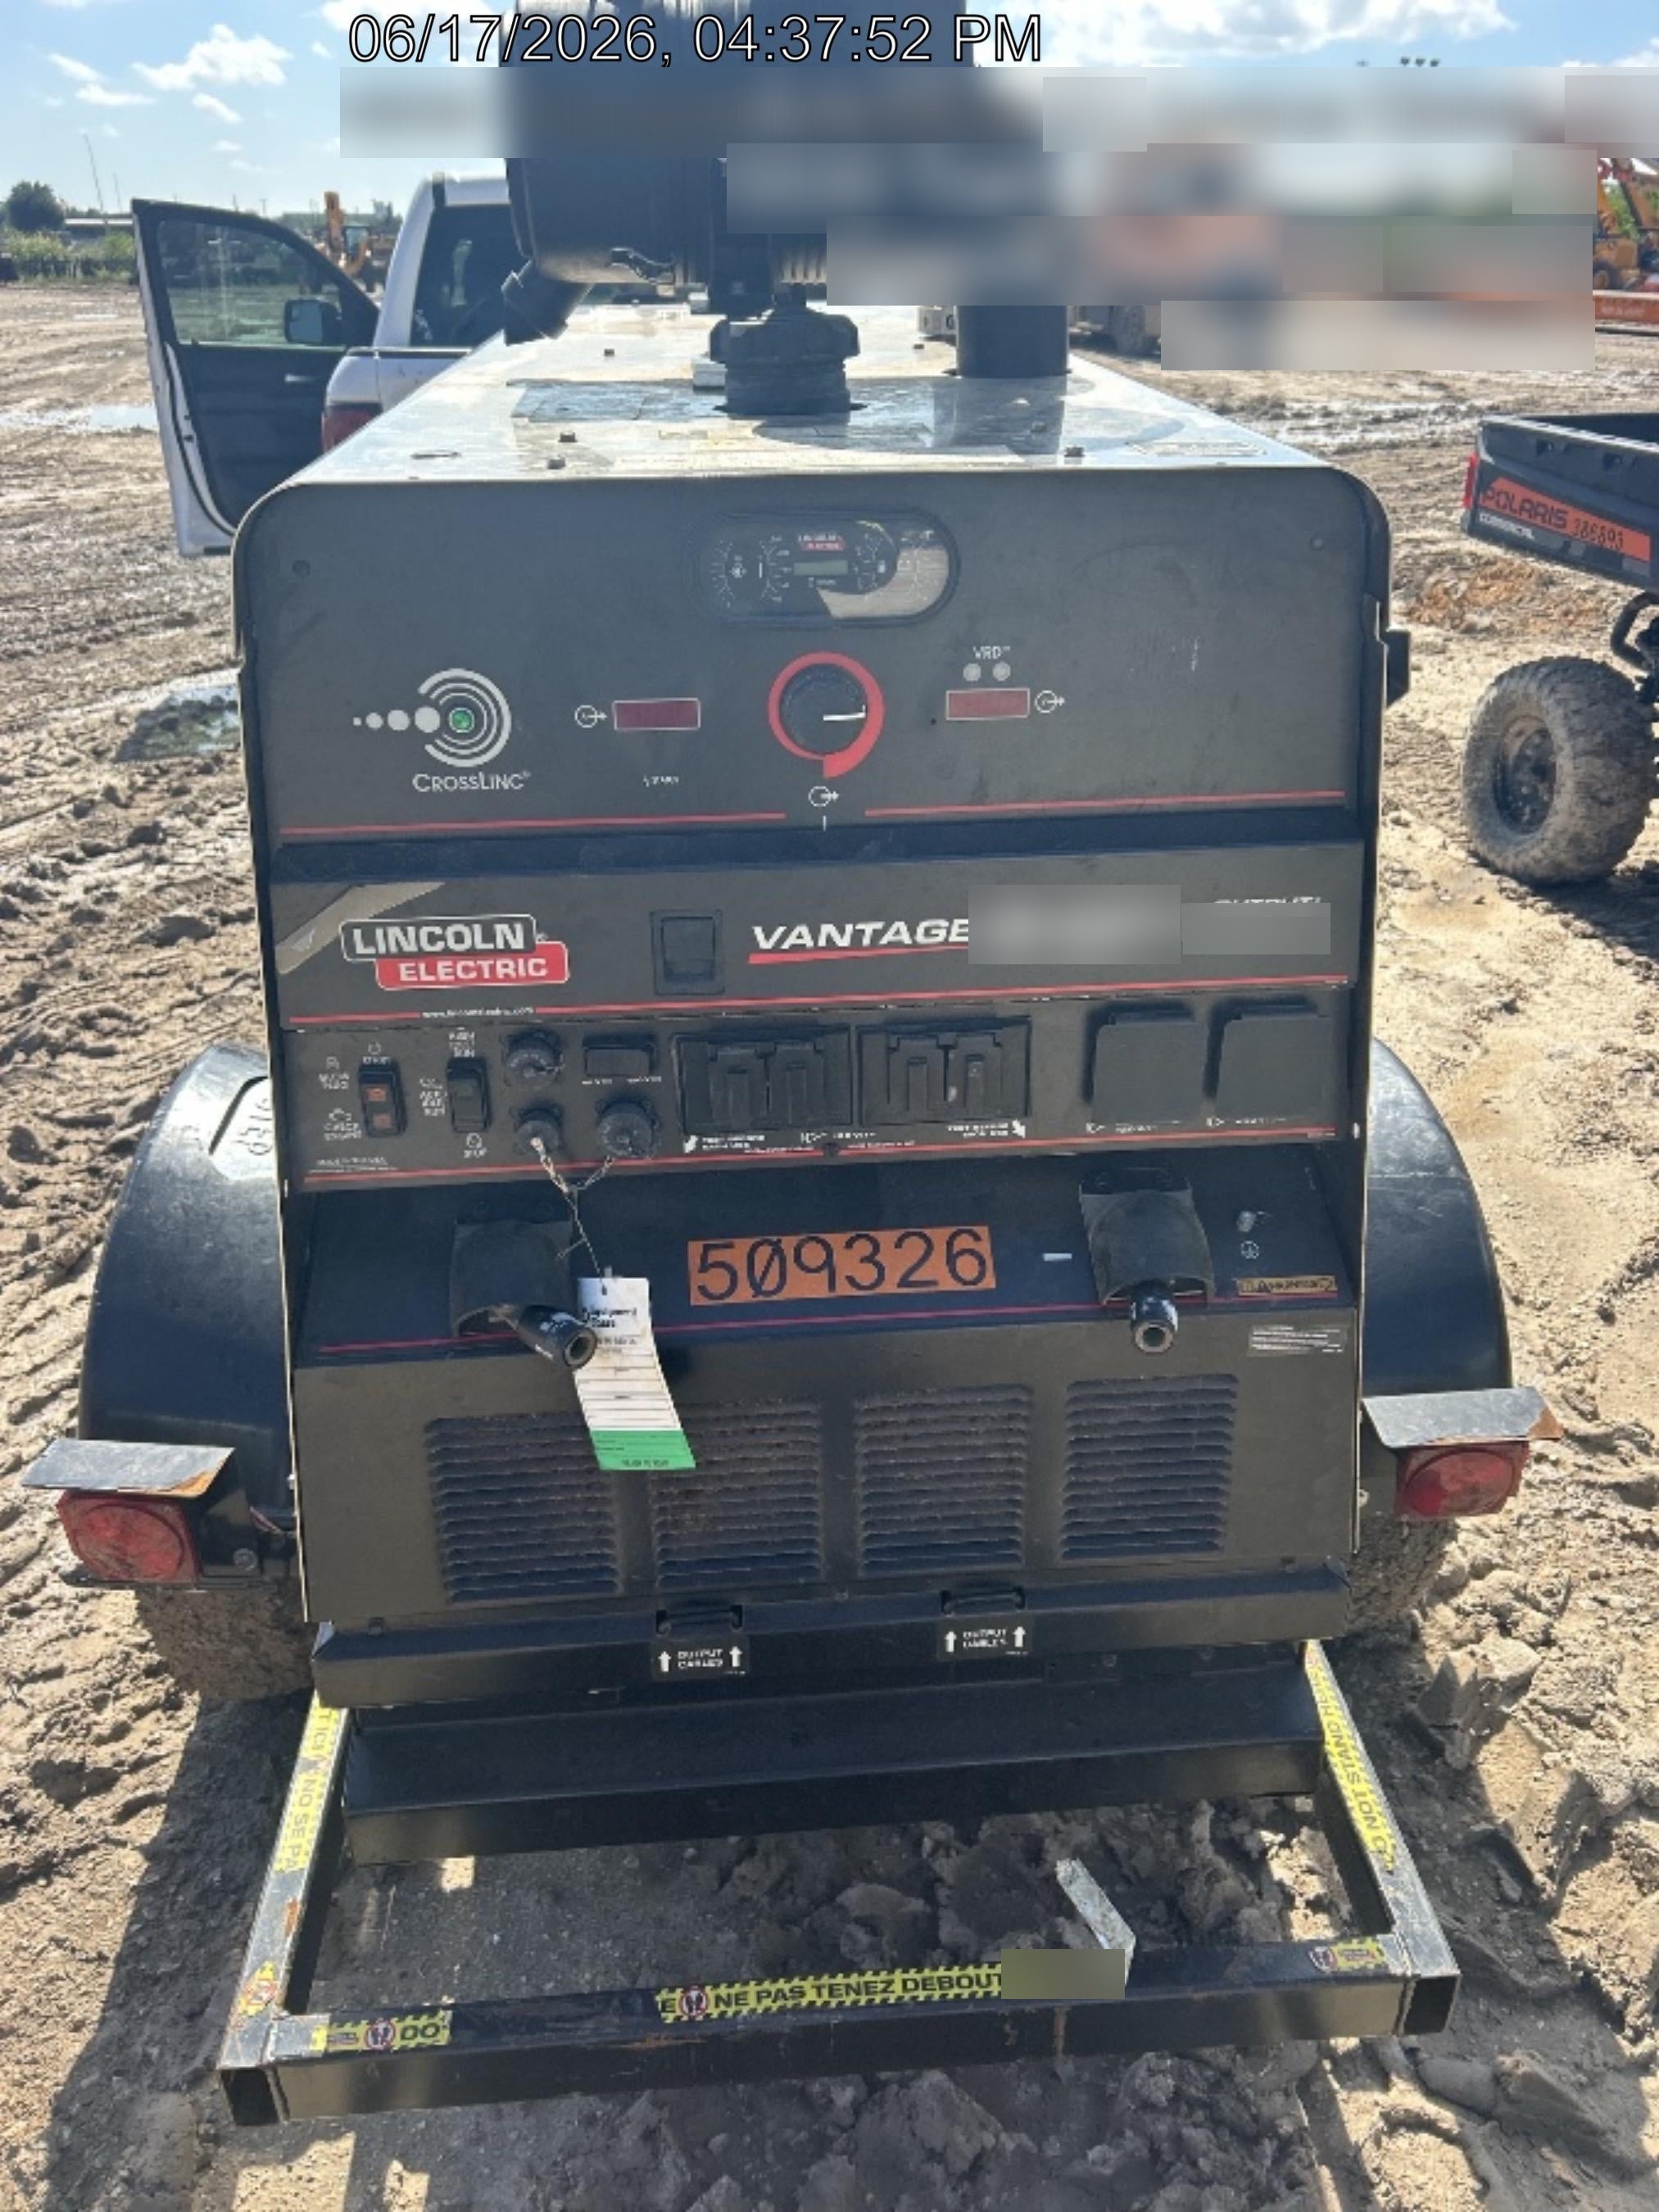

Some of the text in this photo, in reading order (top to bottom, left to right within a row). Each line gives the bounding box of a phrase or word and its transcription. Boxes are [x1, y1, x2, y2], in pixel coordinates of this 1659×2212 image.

[1481, 491, 1569, 528] POLARIS
[353, 923, 524, 954] LINCOLN
[752, 918, 969, 949] VANTAGE
[399, 958, 547, 981] ELECTRIC
[697, 1229, 986, 1300] 509326
[1327, 1720, 1360, 1783] STAND
[298, 1779, 317, 1807] NO
[1353, 1788, 1378, 1829] NOT
[291, 1813, 308, 1839] SE
[714, 1972, 1001, 2009] NE PAS TENEZ DEBOUT
[401, 2022, 440, 2041] DO
